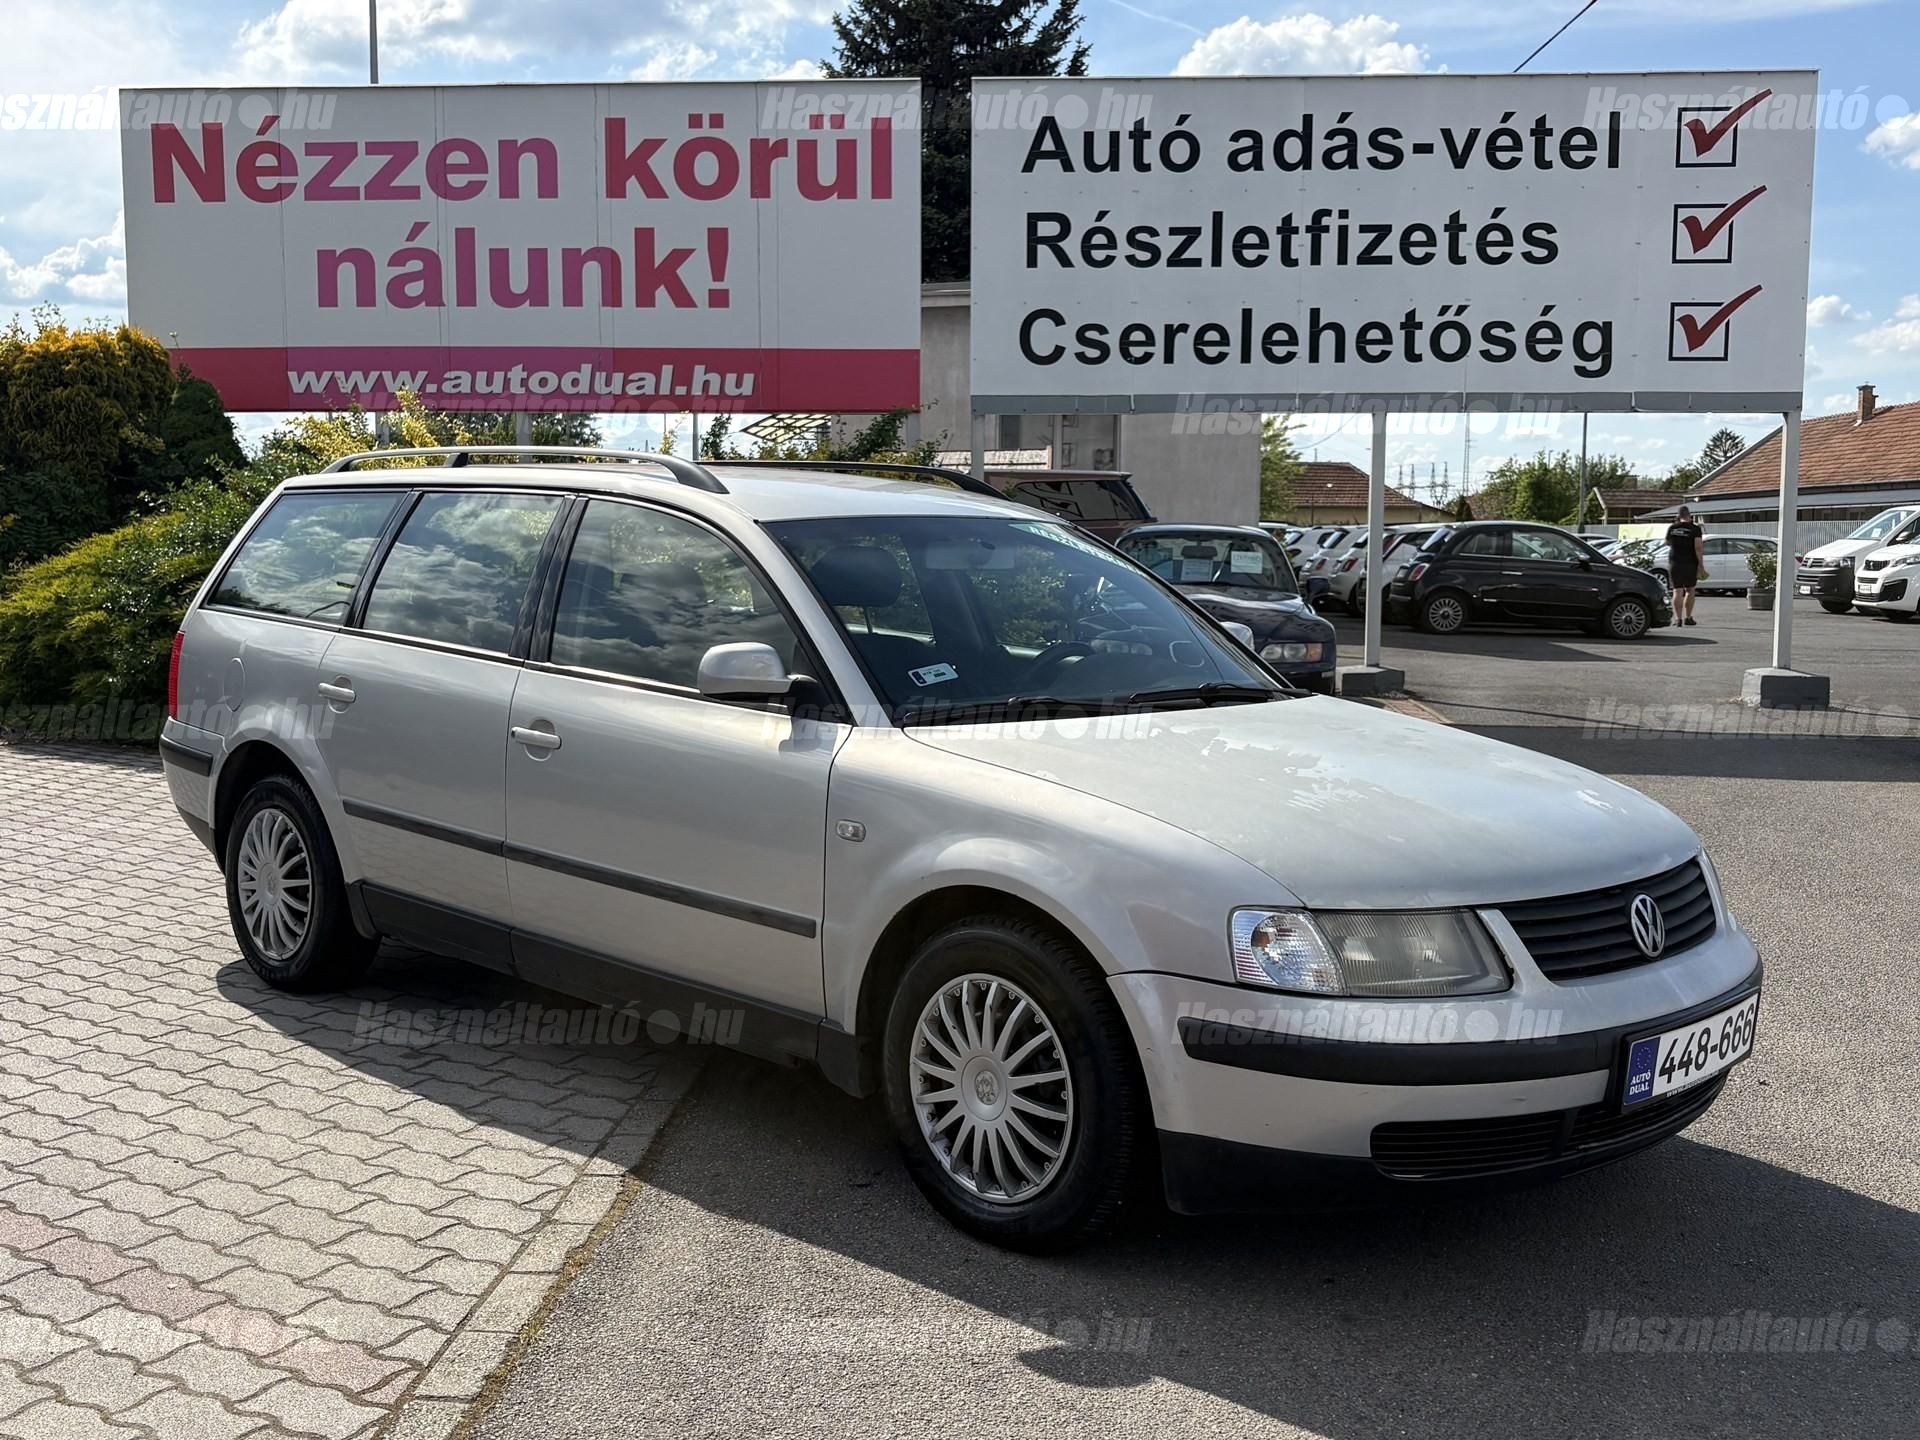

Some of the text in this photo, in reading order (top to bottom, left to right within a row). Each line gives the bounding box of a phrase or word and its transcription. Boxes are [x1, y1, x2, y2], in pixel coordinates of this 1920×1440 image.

[150, 113, 893, 204] Nézzen körül
[1021, 112, 1621, 174] Autó adás-vétel
[317, 221, 731, 309] nálunk!
[1026, 207, 1560, 269] Részletfizetés
[1019, 303, 1614, 378] Cserelehetőség
[288, 363, 755, 397] www.autodual.hu
[1658, 1002, 1755, 1085] 448-666
[1629, 1084, 1651, 1096] DUAL
[1631, 1071, 1652, 1086] AUTÓ
